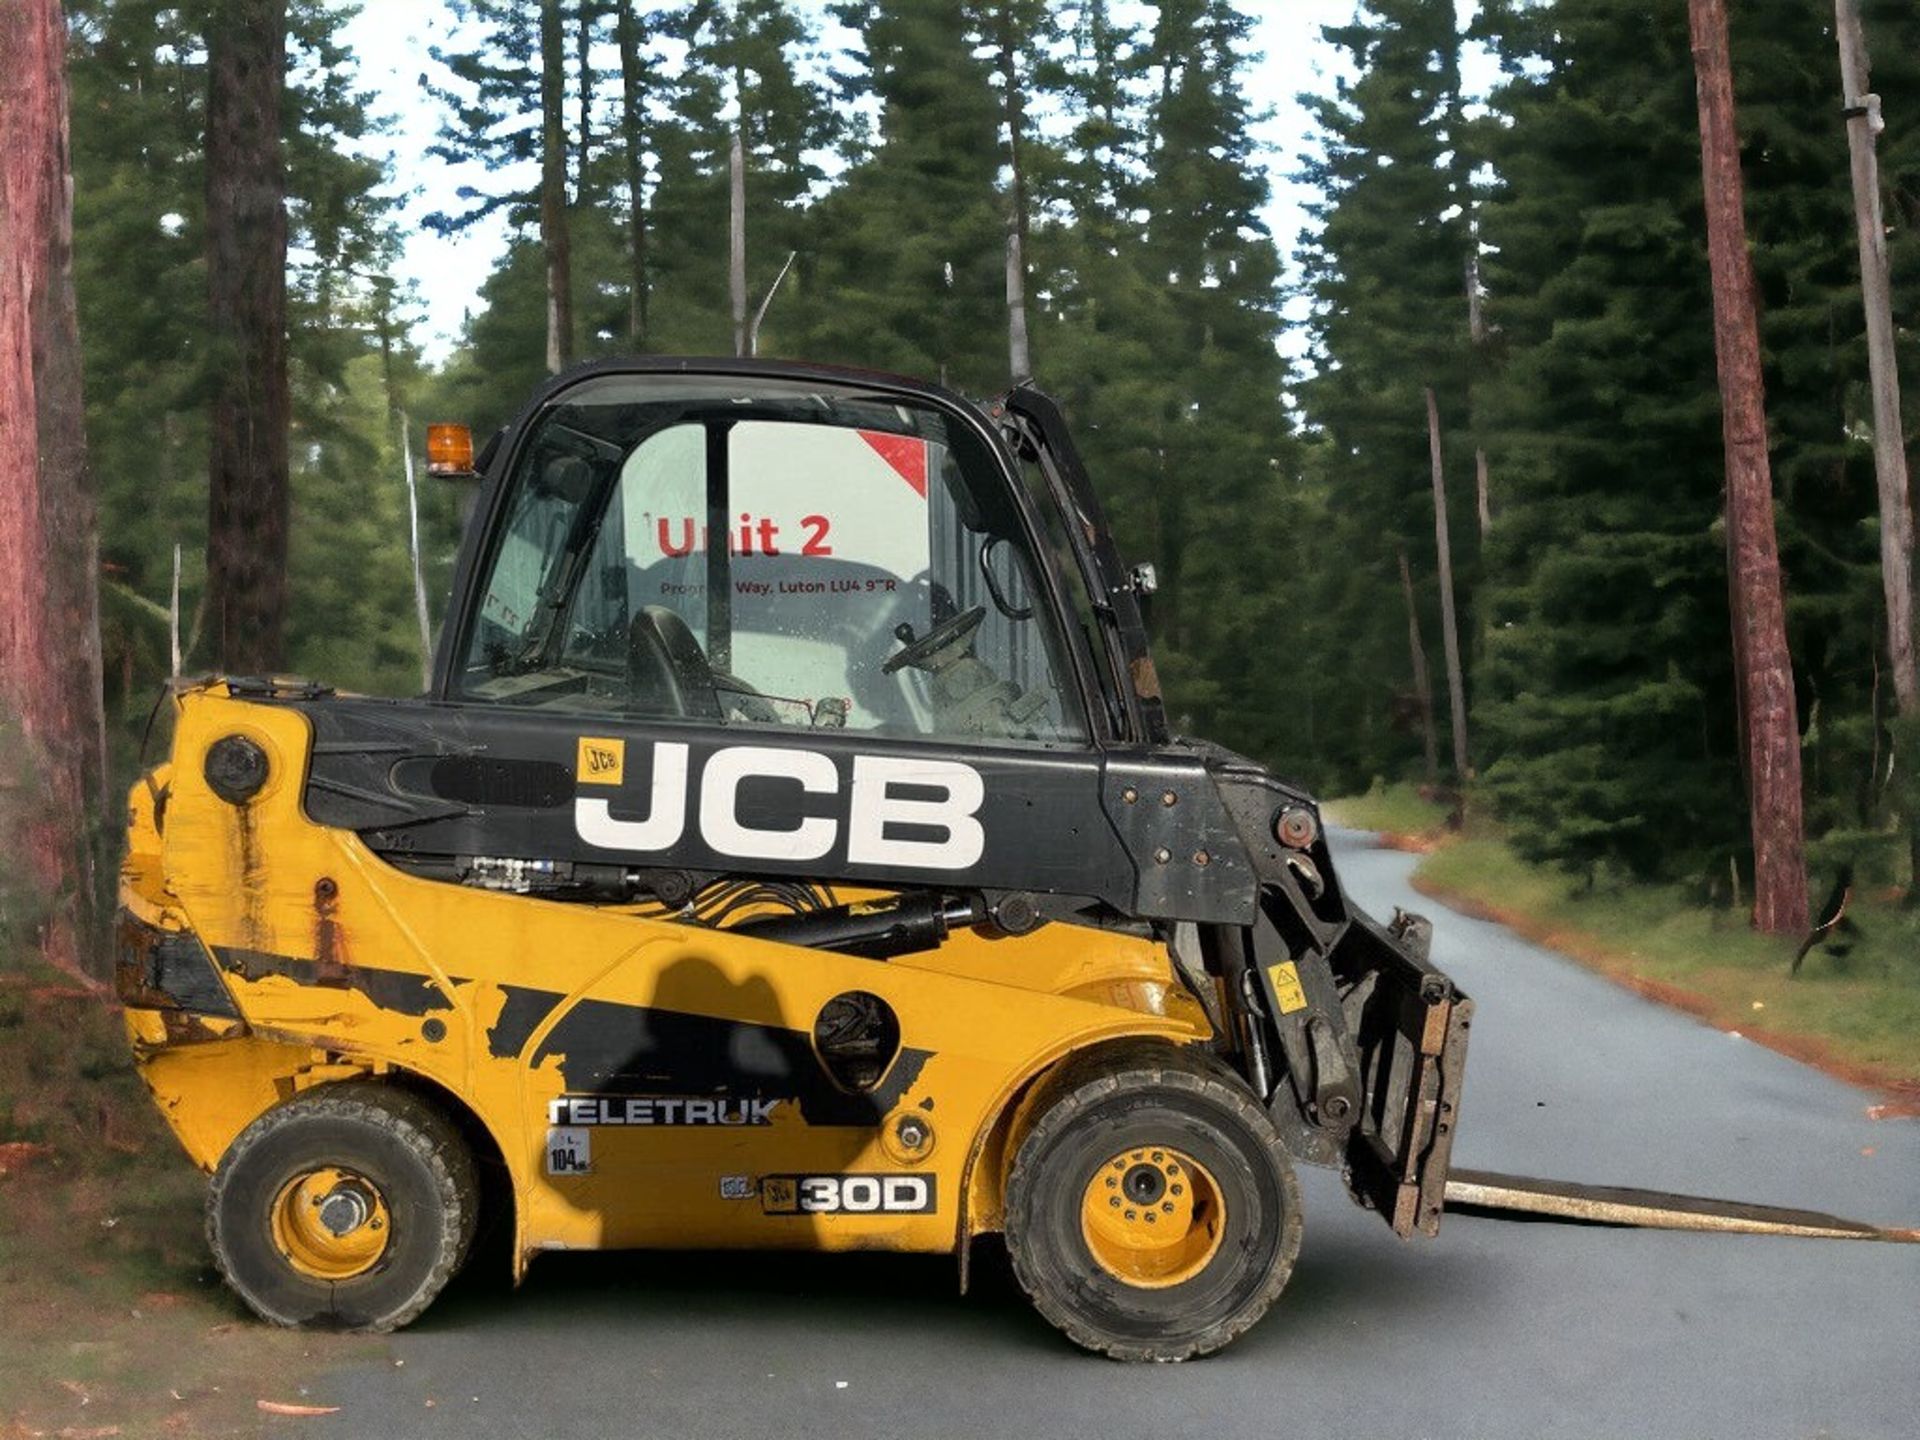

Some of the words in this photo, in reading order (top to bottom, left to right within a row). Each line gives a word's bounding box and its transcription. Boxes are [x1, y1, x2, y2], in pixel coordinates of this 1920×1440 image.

[800, 515, 832, 557] 2
[779, 581, 826, 594] Luton
[830, 580, 861, 593] LU4
[590, 749, 617, 772] JCB
[574, 742, 986, 870] JCB
[549, 1098, 782, 1125] TELETRUK
[800, 1176, 928, 1212] 30D
